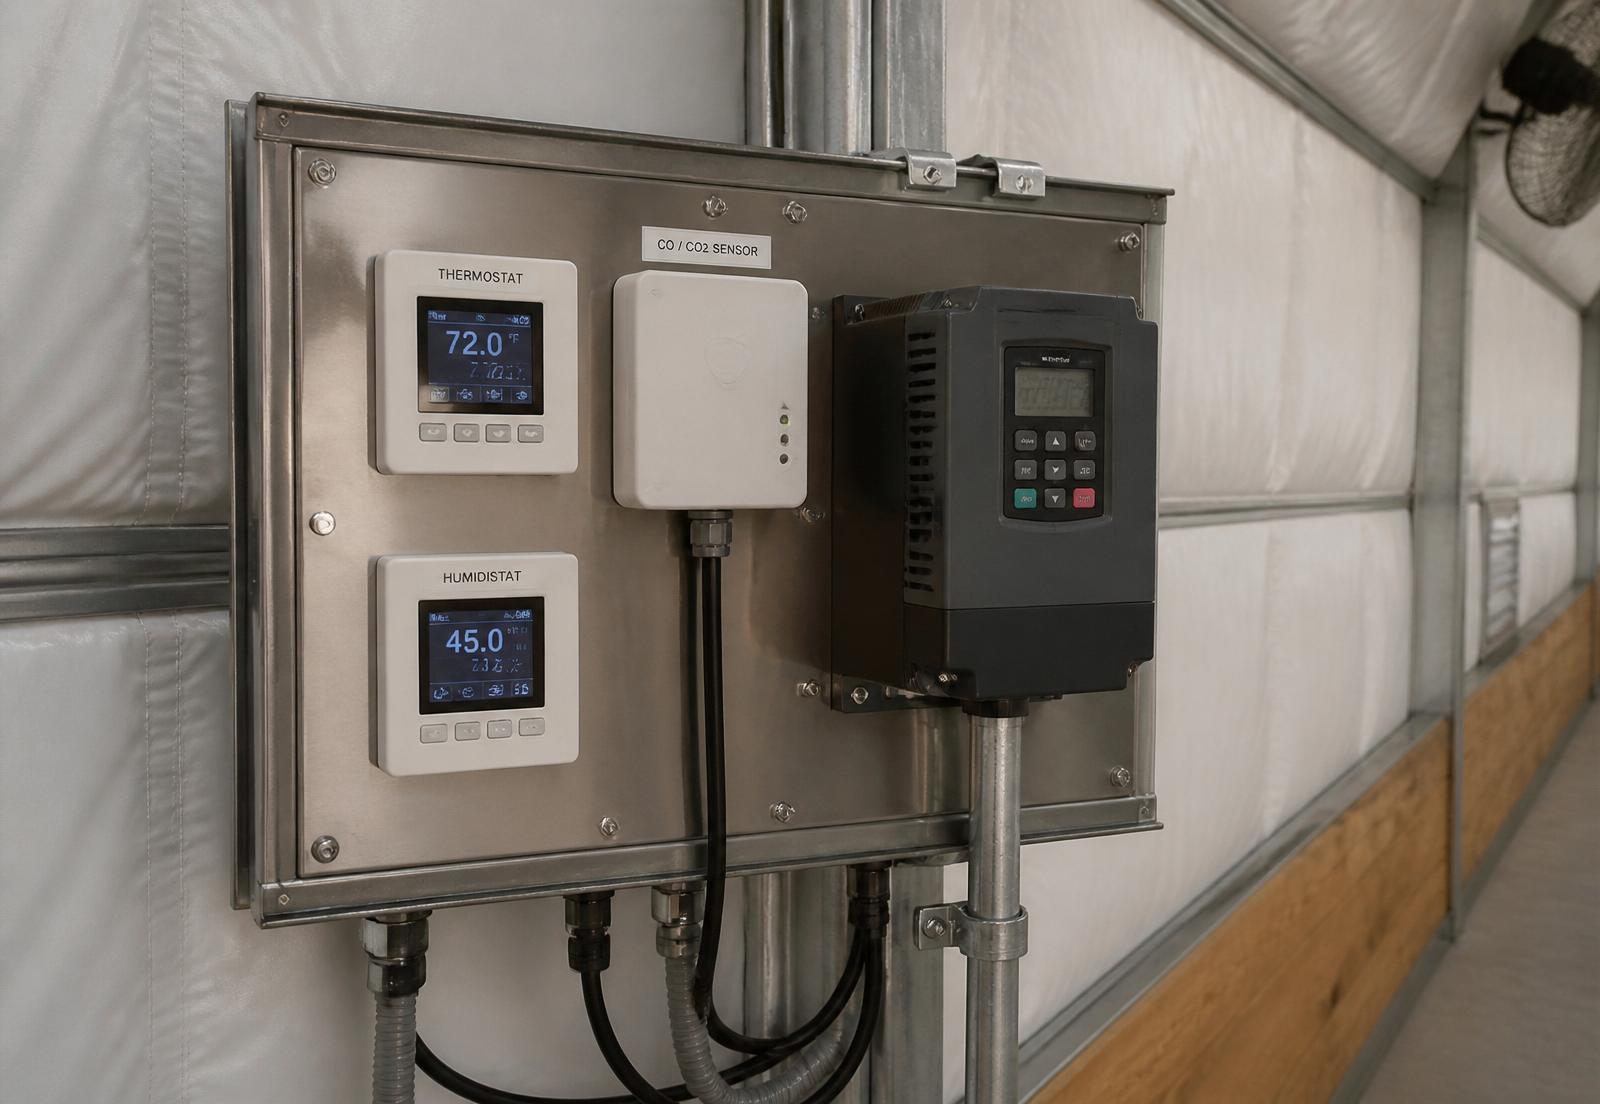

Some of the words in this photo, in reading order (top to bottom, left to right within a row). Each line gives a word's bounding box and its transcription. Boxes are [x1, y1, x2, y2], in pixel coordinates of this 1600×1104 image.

[658, 239, 675, 250] CO
[678, 241, 683, 251] /
[686, 241, 709, 253] CO2
[713, 243, 758, 256] SENSOR
[438, 268, 523, 284] THERMOSTAT
[446, 330, 503, 357] 72.0
[443, 570, 522, 583] HUMIDISTAT
[446, 628, 503, 653] 45.0
